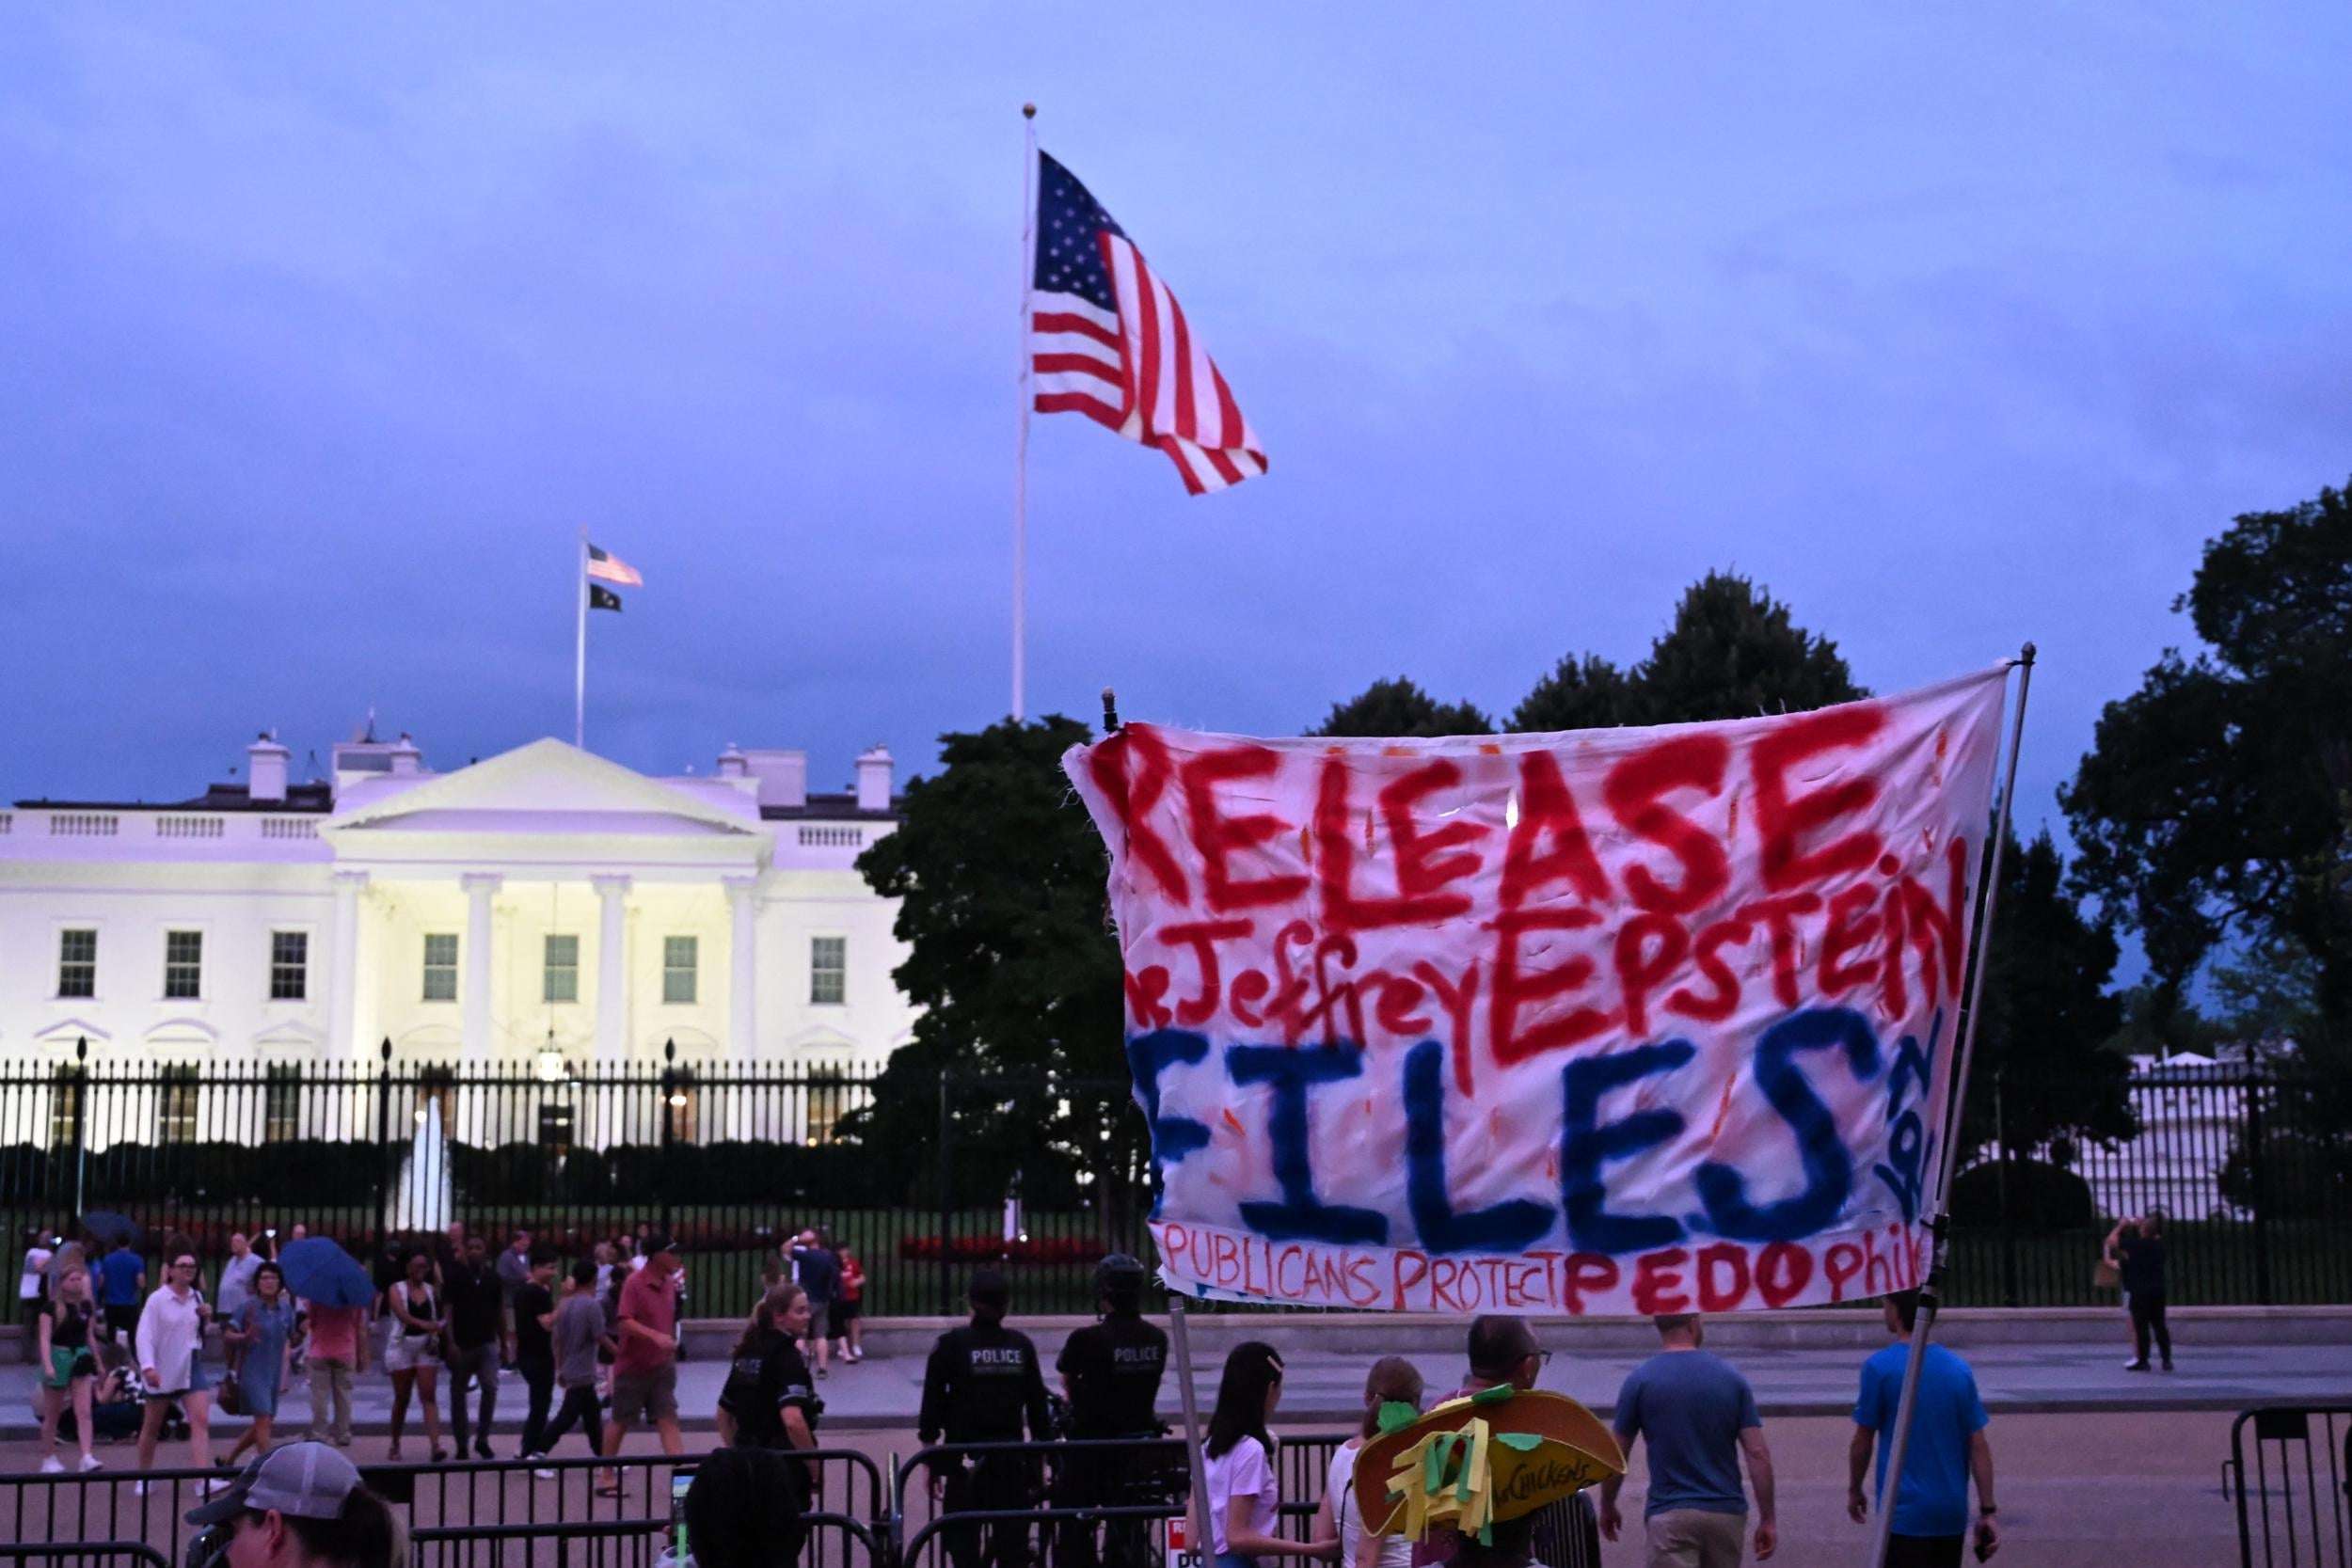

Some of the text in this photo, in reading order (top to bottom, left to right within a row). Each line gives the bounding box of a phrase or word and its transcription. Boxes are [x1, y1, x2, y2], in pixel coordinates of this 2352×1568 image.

[1089, 702, 1886, 931] RELEASE
[1129, 1006, 1882, 1255] FILES
[1163, 1222, 1381, 1307] PUBLICANS
[1392, 1249, 1563, 1311] PROTECT
[972, 1349, 1024, 1363] POLICE
[1114, 1346, 1160, 1363] POLICE
